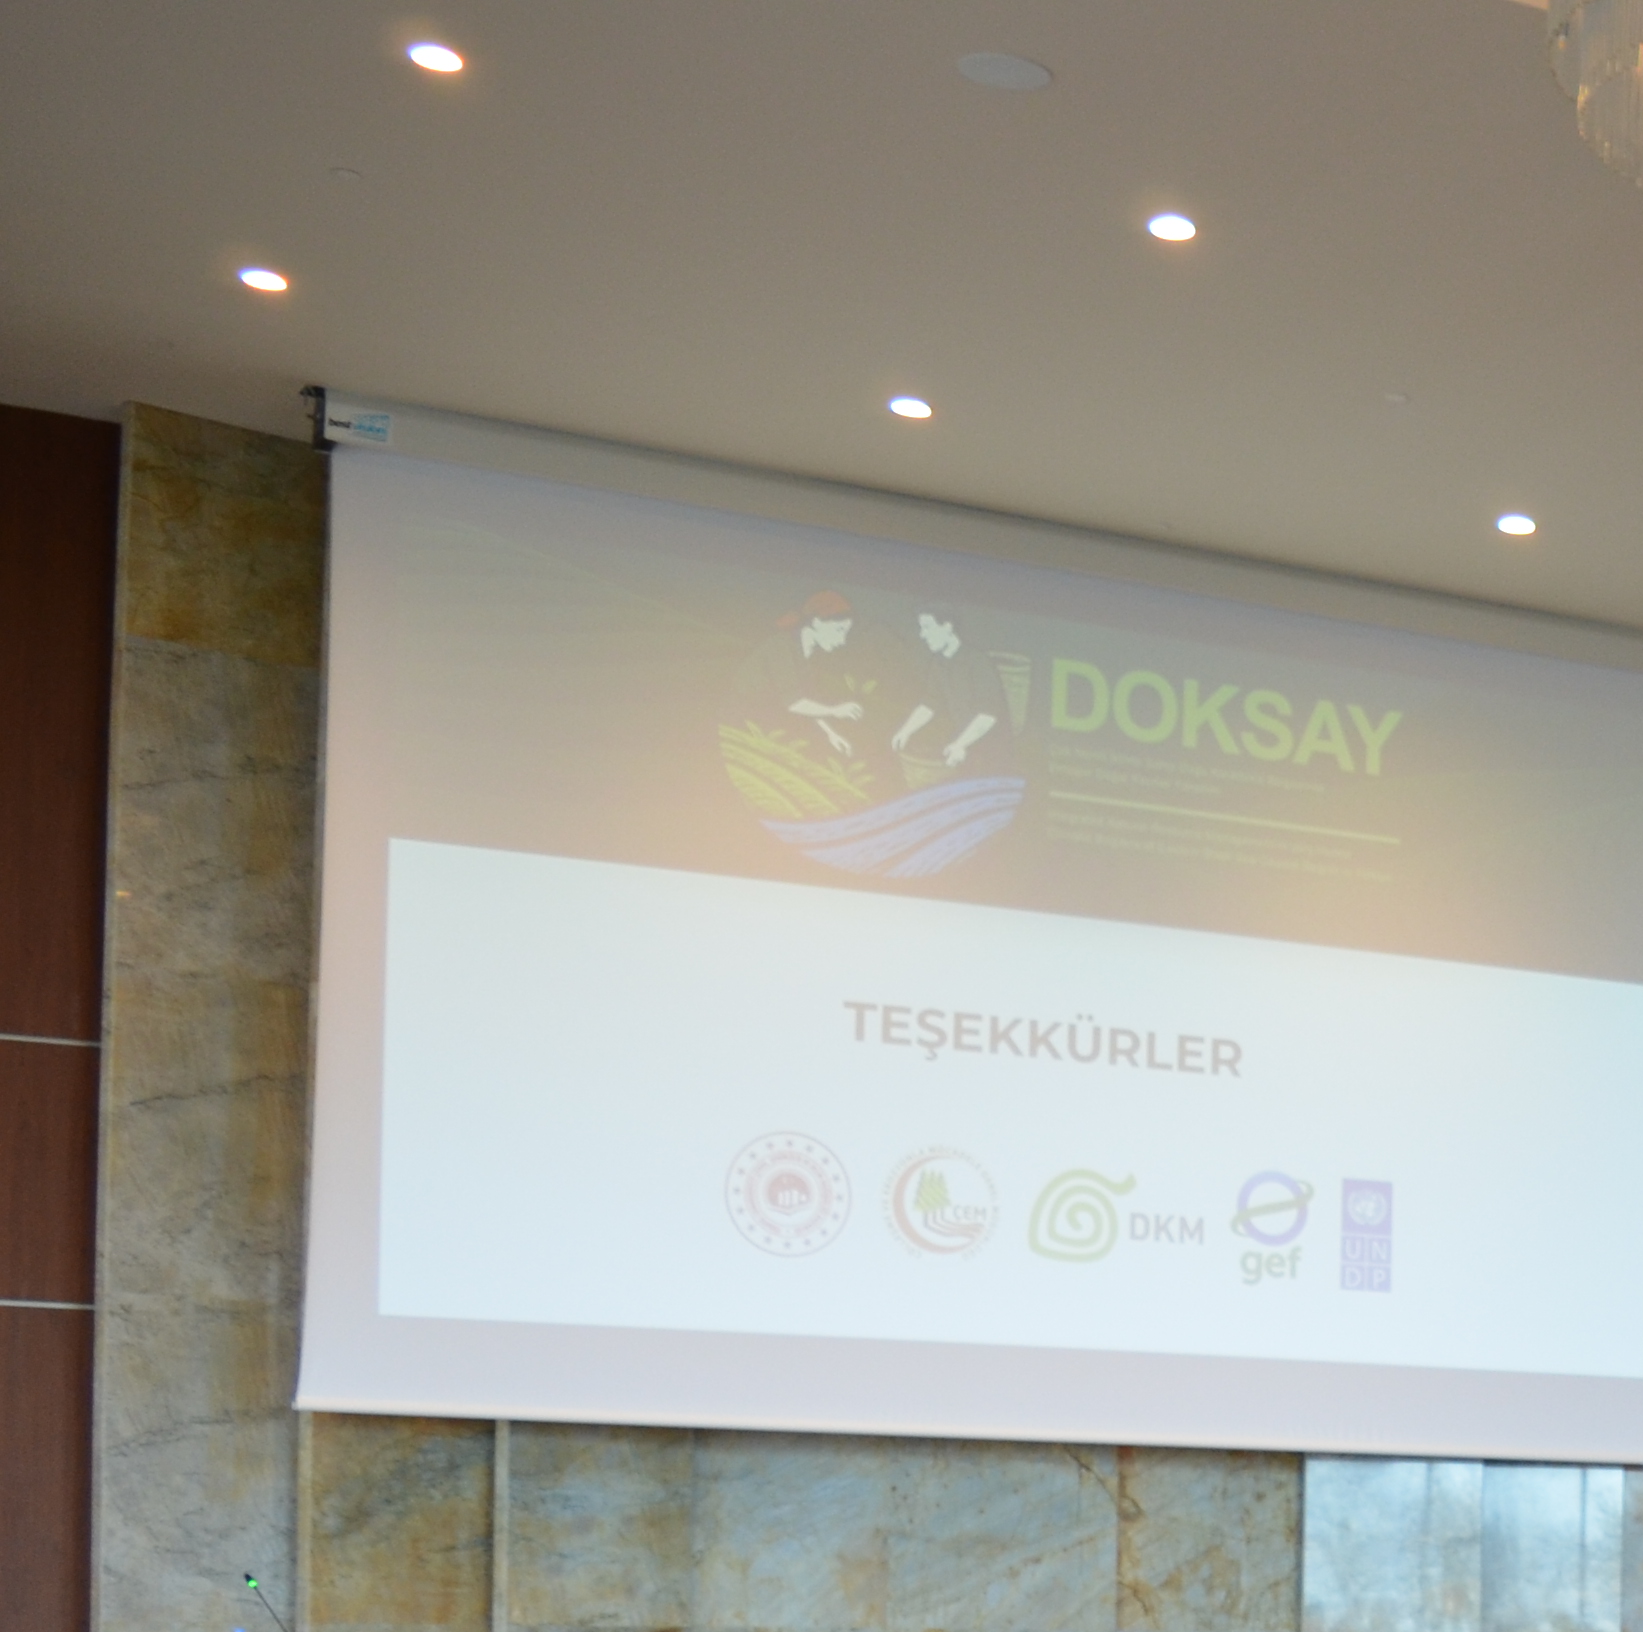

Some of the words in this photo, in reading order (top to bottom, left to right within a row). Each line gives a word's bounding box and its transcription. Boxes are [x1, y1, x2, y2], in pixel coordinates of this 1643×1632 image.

[1050, 657, 1402, 777] DOKSAY
[843, 1000, 1243, 1078] TEŞEKKÜRLER
[1129, 1212, 1204, 1245] DKM
[1240, 1247, 1303, 1286] gef
